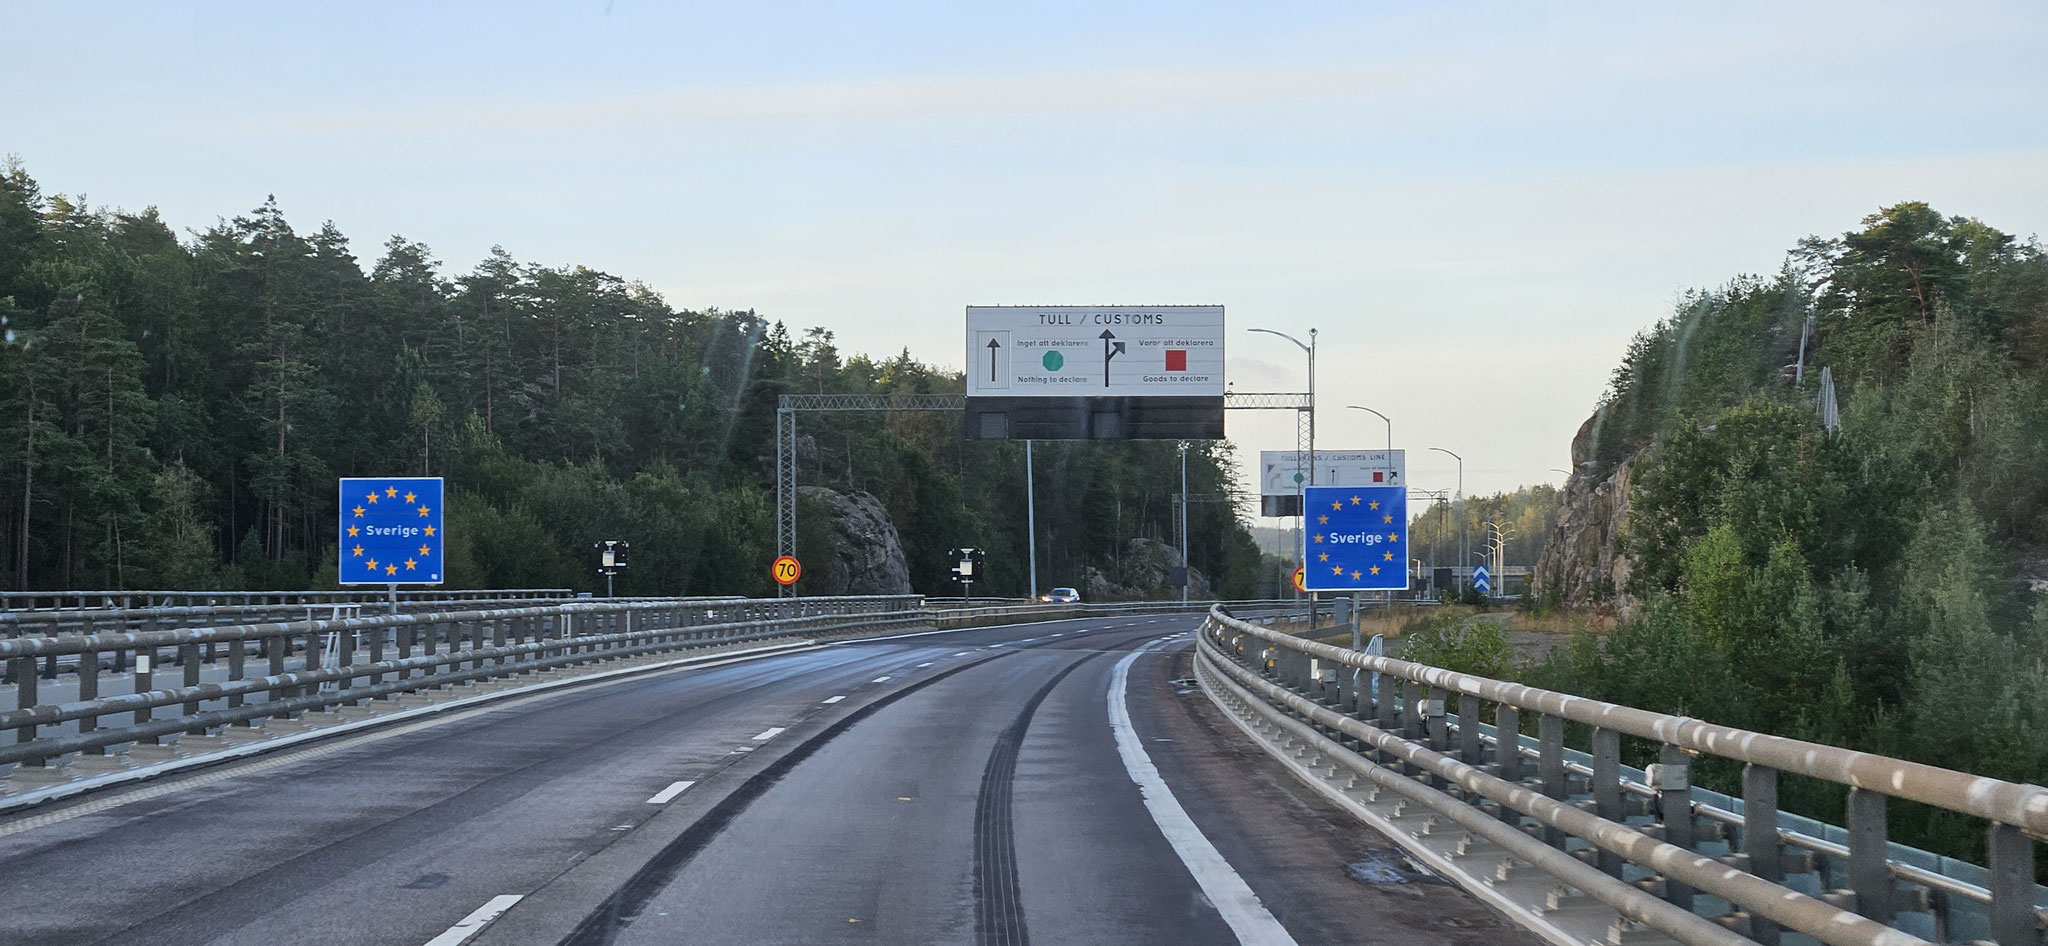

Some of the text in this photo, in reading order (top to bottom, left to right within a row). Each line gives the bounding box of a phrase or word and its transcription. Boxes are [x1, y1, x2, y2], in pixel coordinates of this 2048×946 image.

[1039, 314, 1163, 325] TULL / CUSTOMS
[1017, 340, 1036, 348] Inget
[1018, 376, 1047, 384] Nothing
[366, 525, 419, 538] Sverige
[1329, 532, 1383, 546] Sverige
[779, 563, 797, 577] 70
